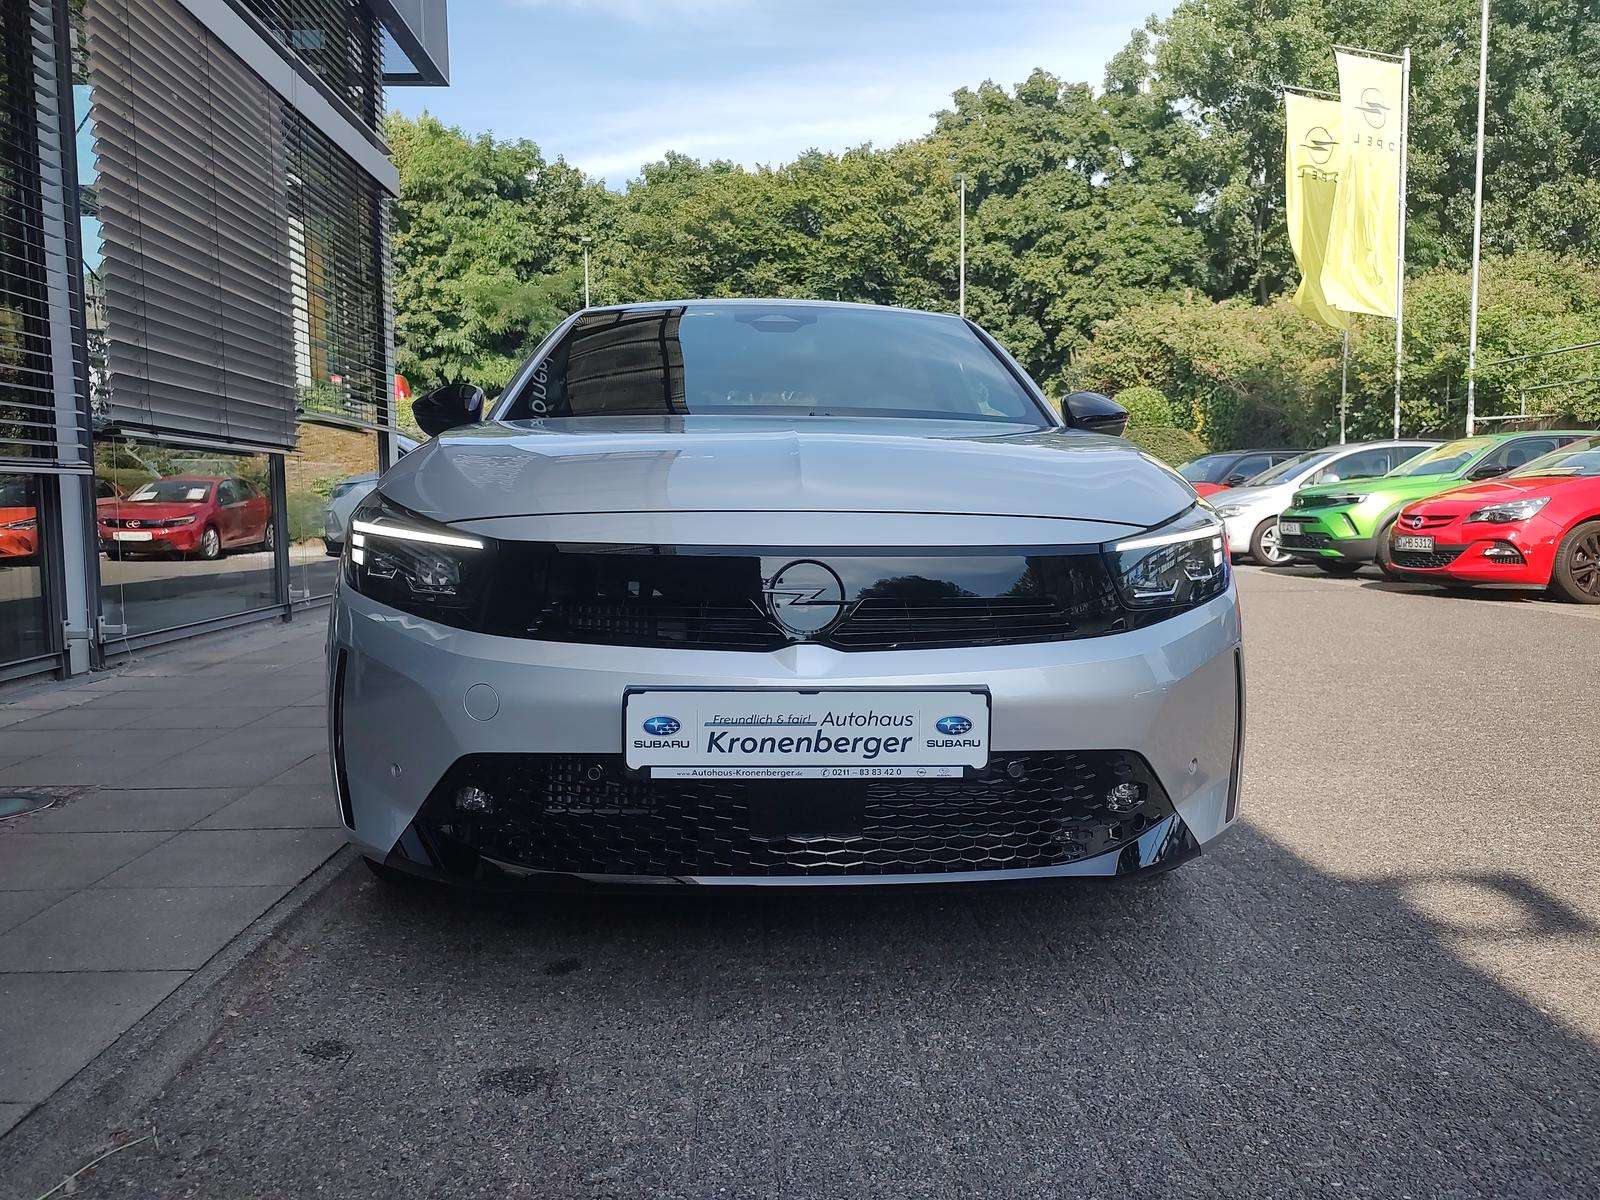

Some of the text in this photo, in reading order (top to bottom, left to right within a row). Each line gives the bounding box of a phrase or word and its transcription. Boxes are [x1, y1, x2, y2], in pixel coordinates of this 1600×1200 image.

[1414, 538, 1432, 549] 5312
[712, 713, 812, 725] Freundlich & fair!
[820, 710, 914, 727] Autohaus
[633, 740, 690, 749] SUBARU
[706, 729, 914, 760] Kronenberger
[926, 739, 981, 748] SUBARU
[832, 768, 850, 776] 0211
[859, 768, 870, 776] 83
[871, 768, 882, 776] 83
[883, 768, 895, 776] 42
